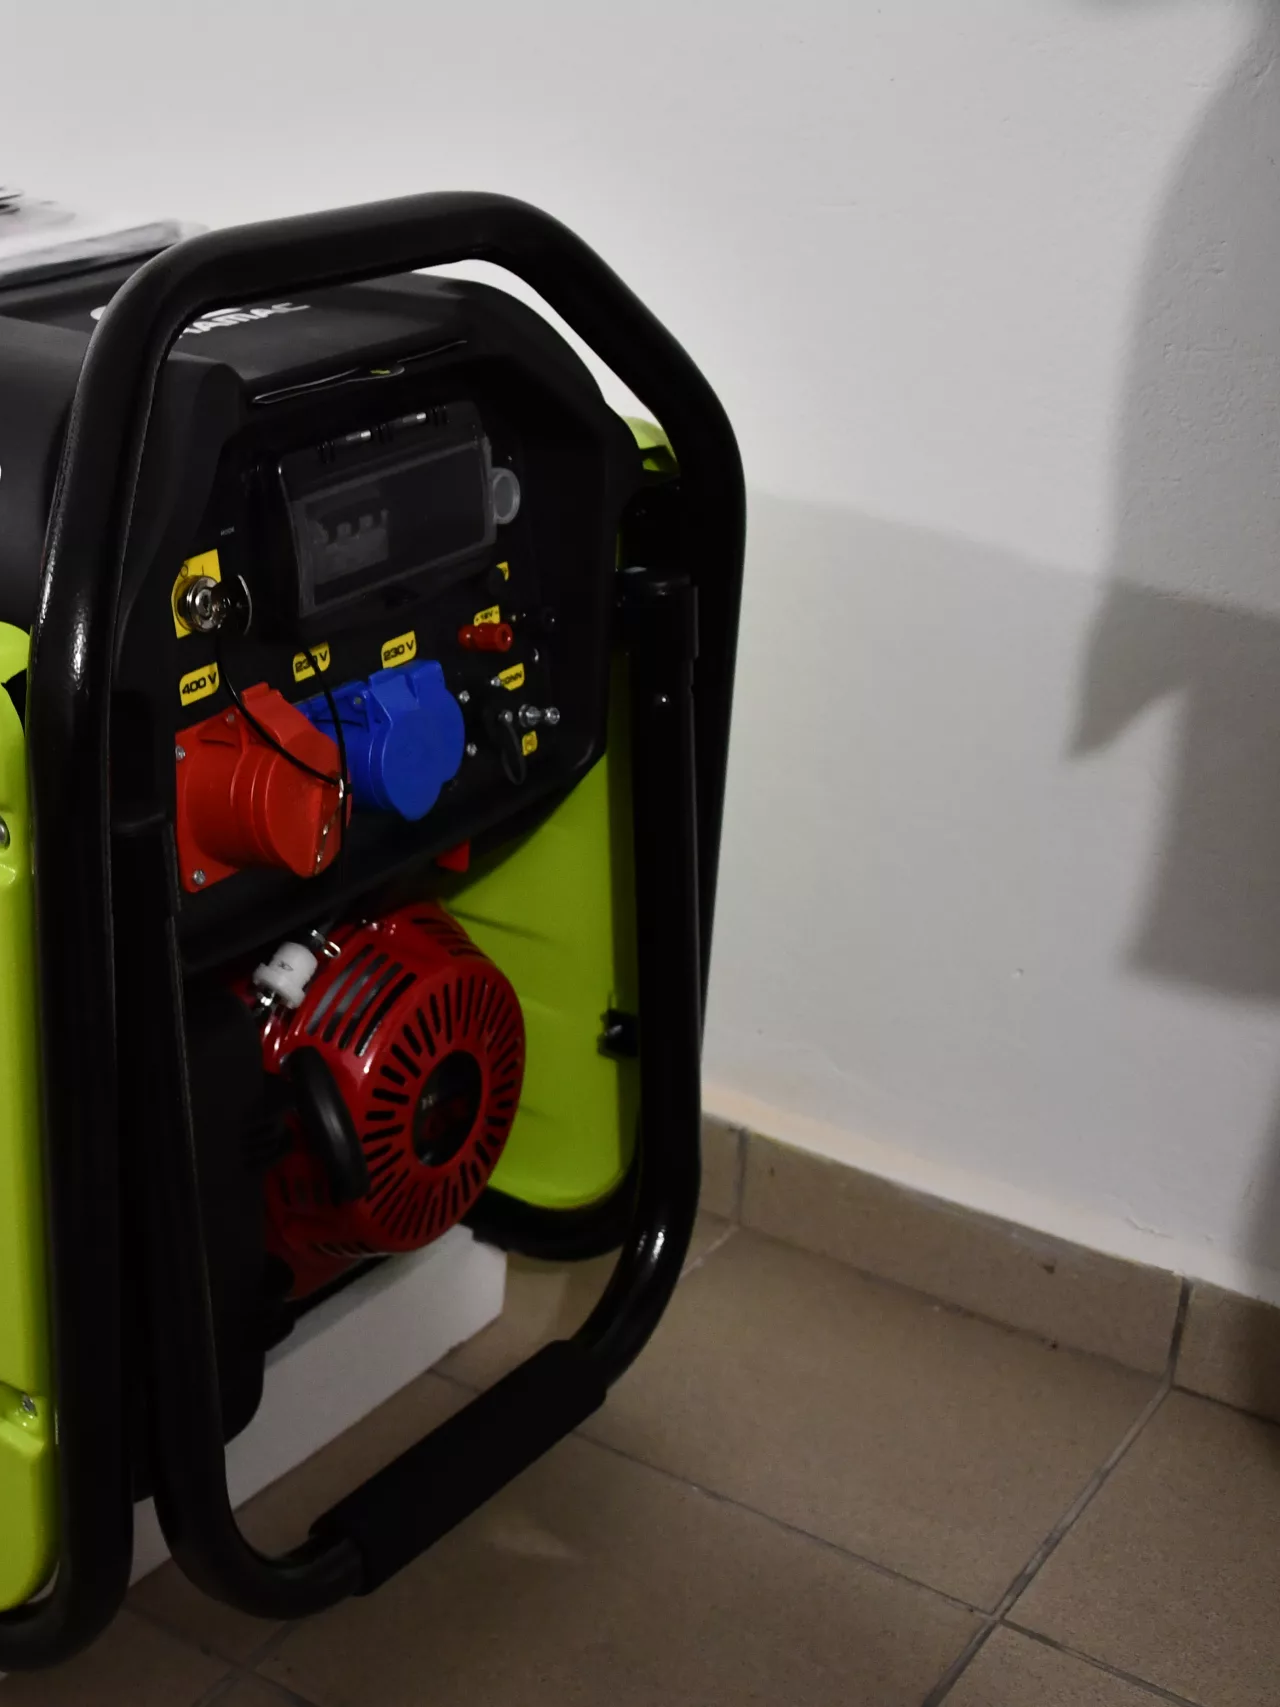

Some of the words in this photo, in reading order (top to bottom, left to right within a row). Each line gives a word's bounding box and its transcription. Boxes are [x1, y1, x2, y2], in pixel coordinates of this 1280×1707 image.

[179, 302, 311, 339] AMAC
[319, 649, 328, 662] V
[383, 645, 404, 661] 230
[406, 639, 415, 652] V
[182, 676, 207, 695] 400
[208, 671, 217, 685] V
